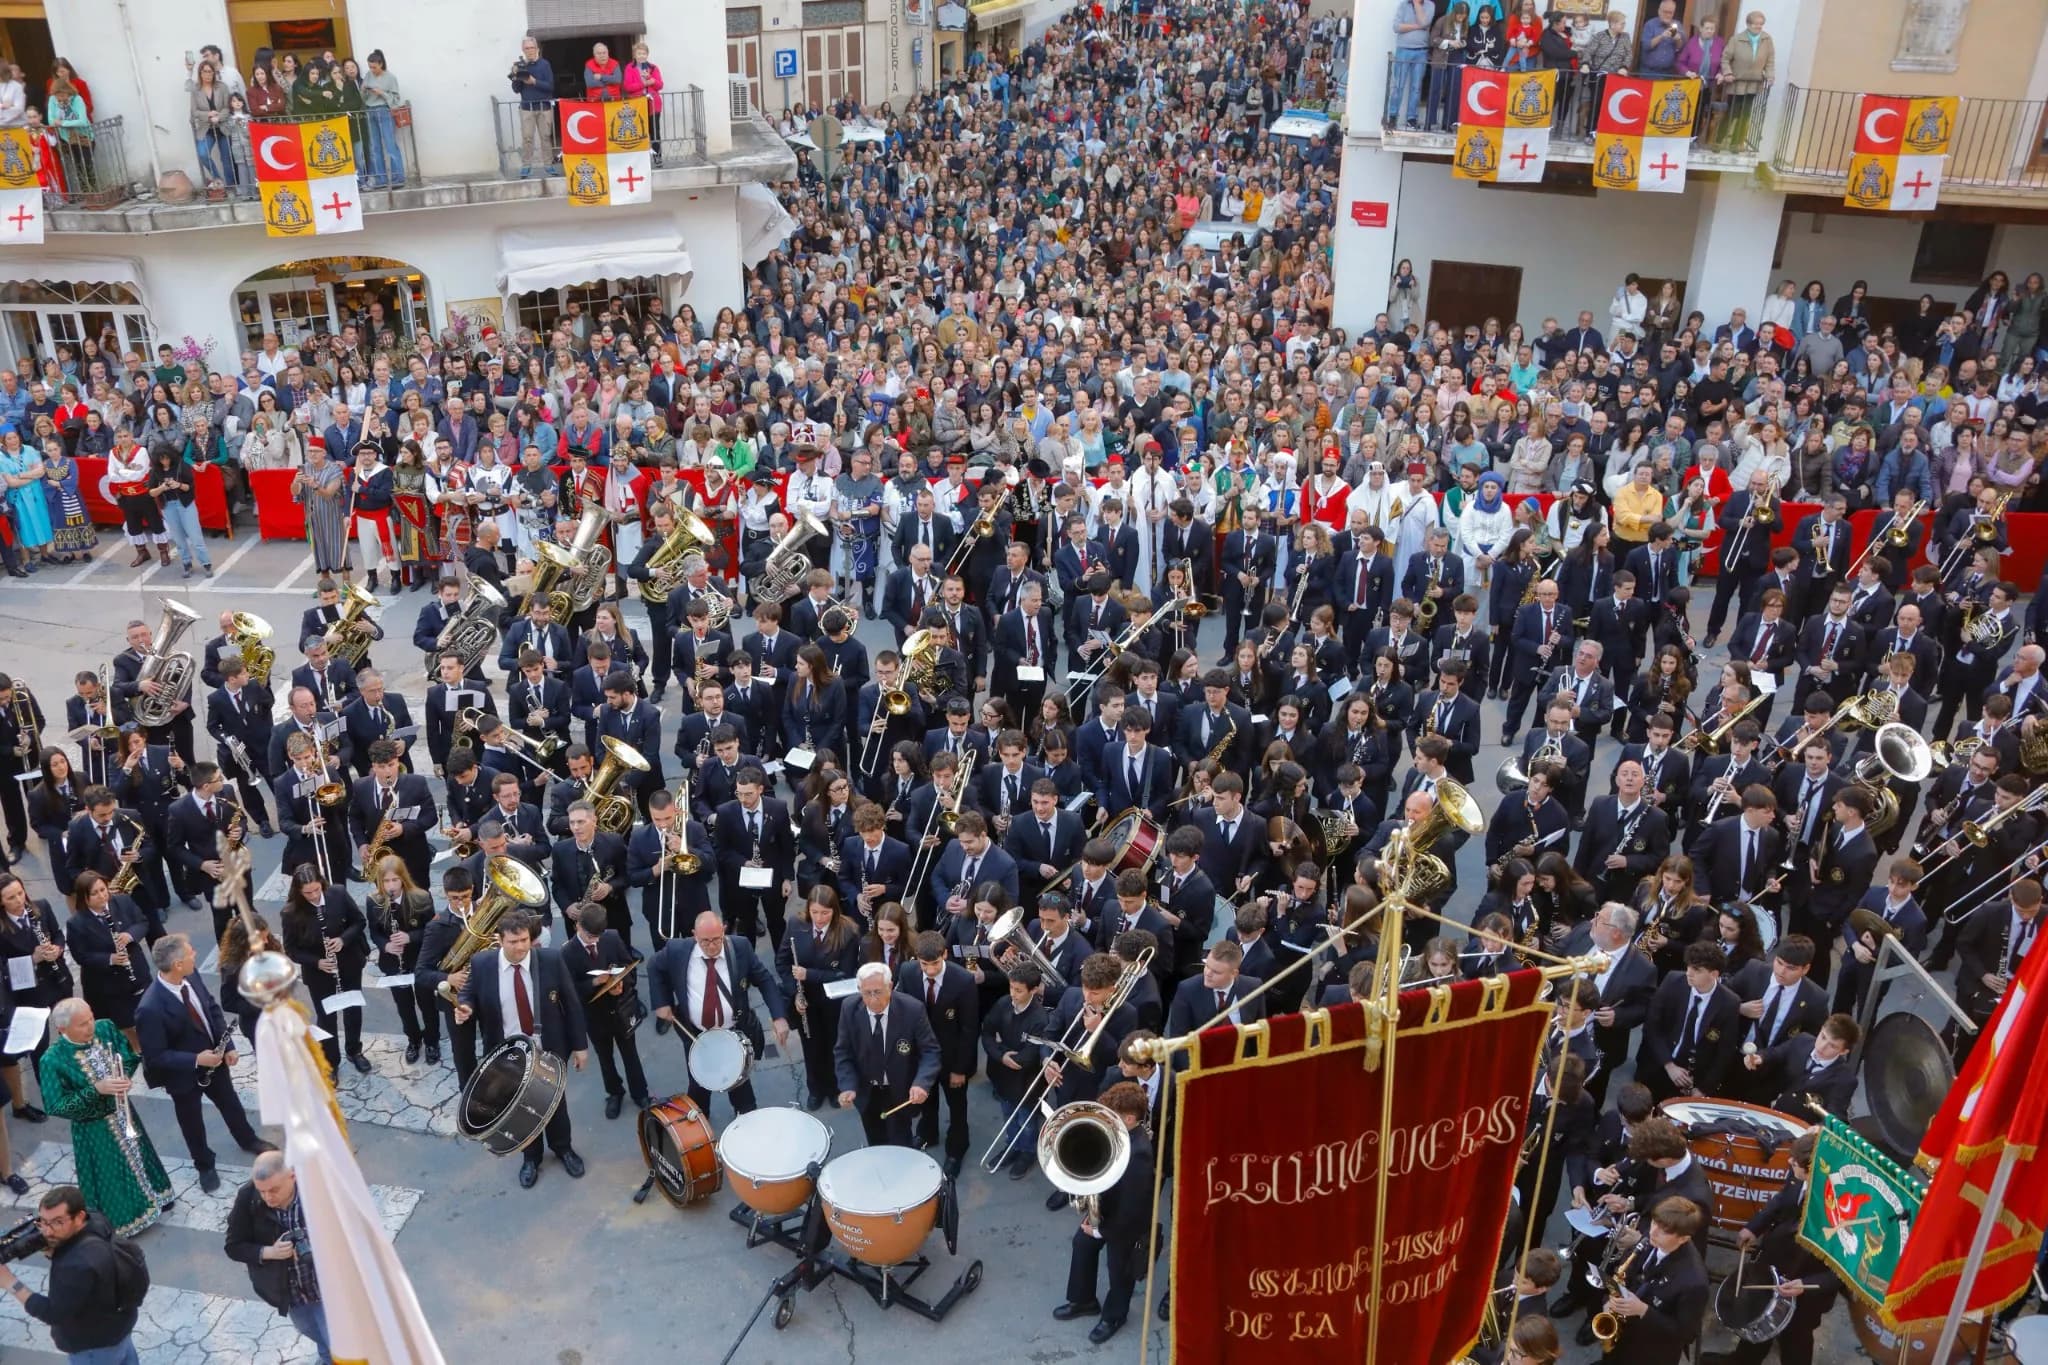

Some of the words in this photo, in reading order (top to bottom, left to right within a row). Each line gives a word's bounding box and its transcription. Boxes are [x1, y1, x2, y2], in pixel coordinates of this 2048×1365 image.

[890, 0, 899, 94] ROGUERIA
[779, 52, 793, 74] P
[1288, 1310, 1339, 1341] LA
